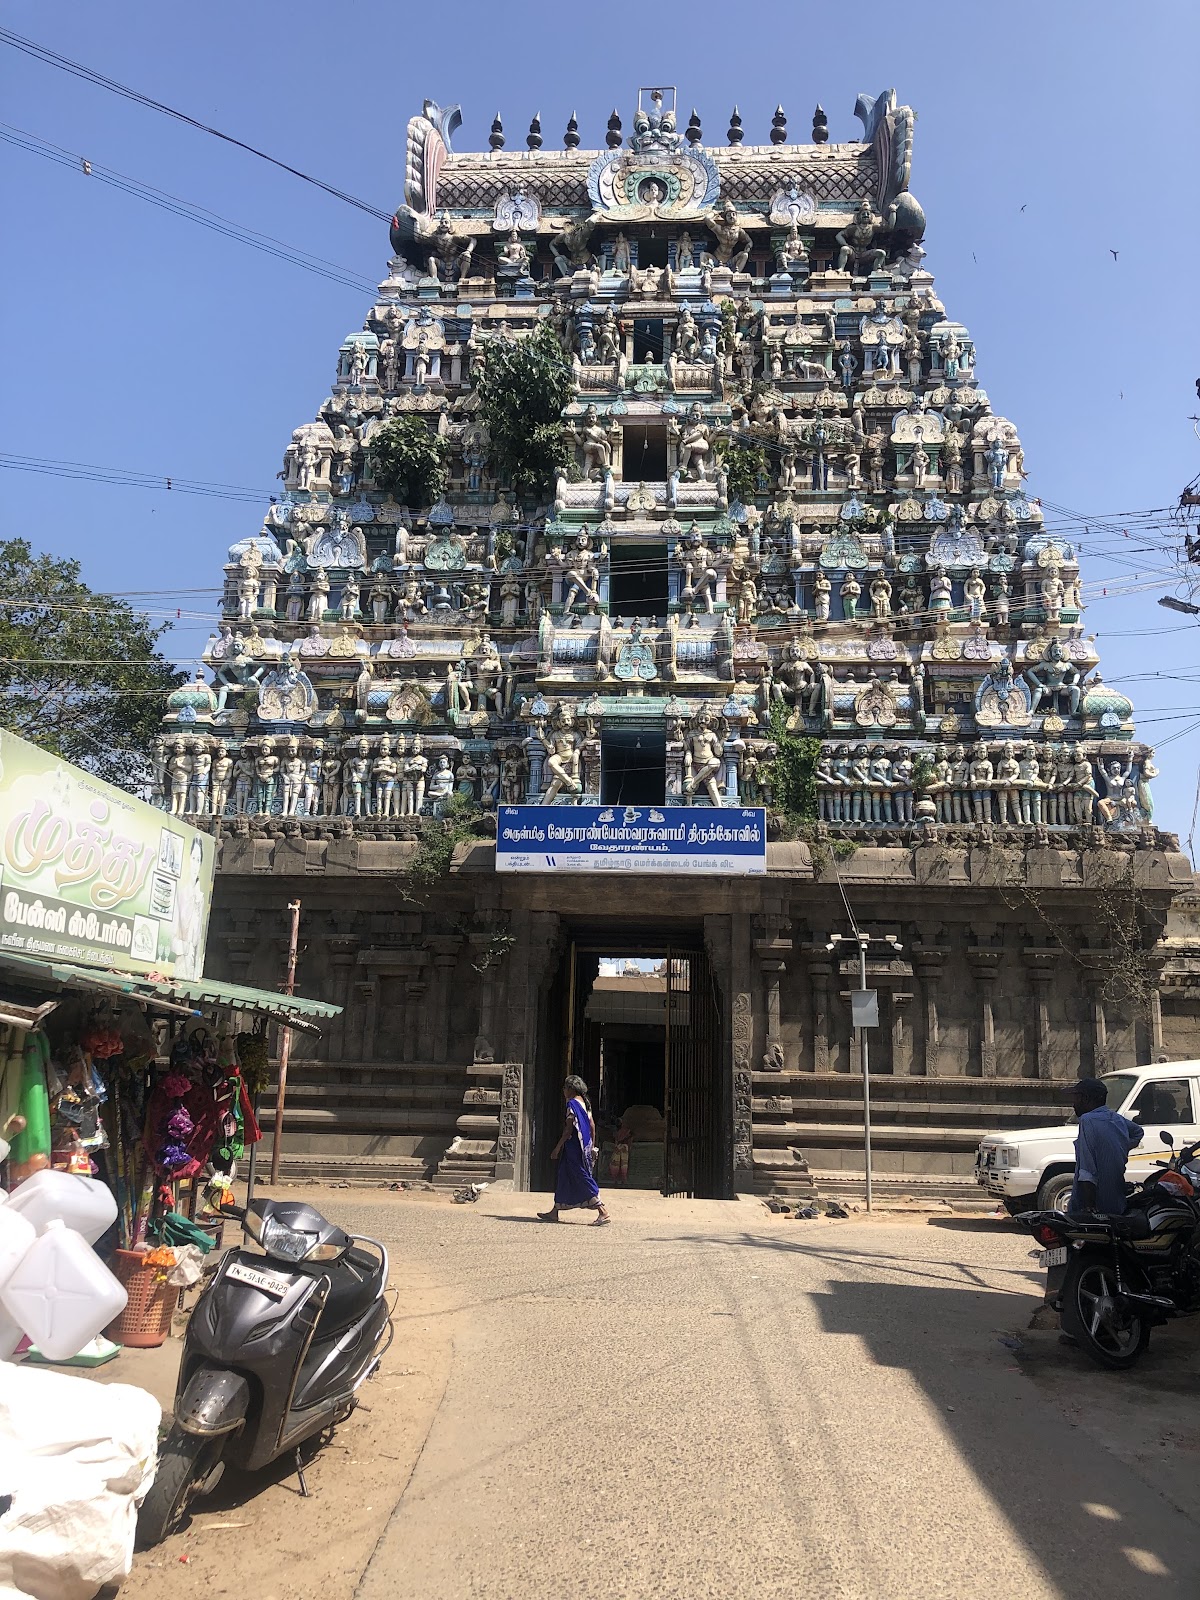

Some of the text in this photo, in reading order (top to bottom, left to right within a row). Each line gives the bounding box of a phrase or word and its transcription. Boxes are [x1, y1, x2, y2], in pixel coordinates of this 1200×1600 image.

[504, 807, 519, 816] சிவ
[742, 809, 756, 818] சிவ
[502, 821, 761, 845] அருள்மிகு வேதாரண்யேஸ்வரசுவாமி திருக்கோவில்
[5, 799, 155, 908] முத்து
[593, 858, 632, 869] தமிழ்நாடு
